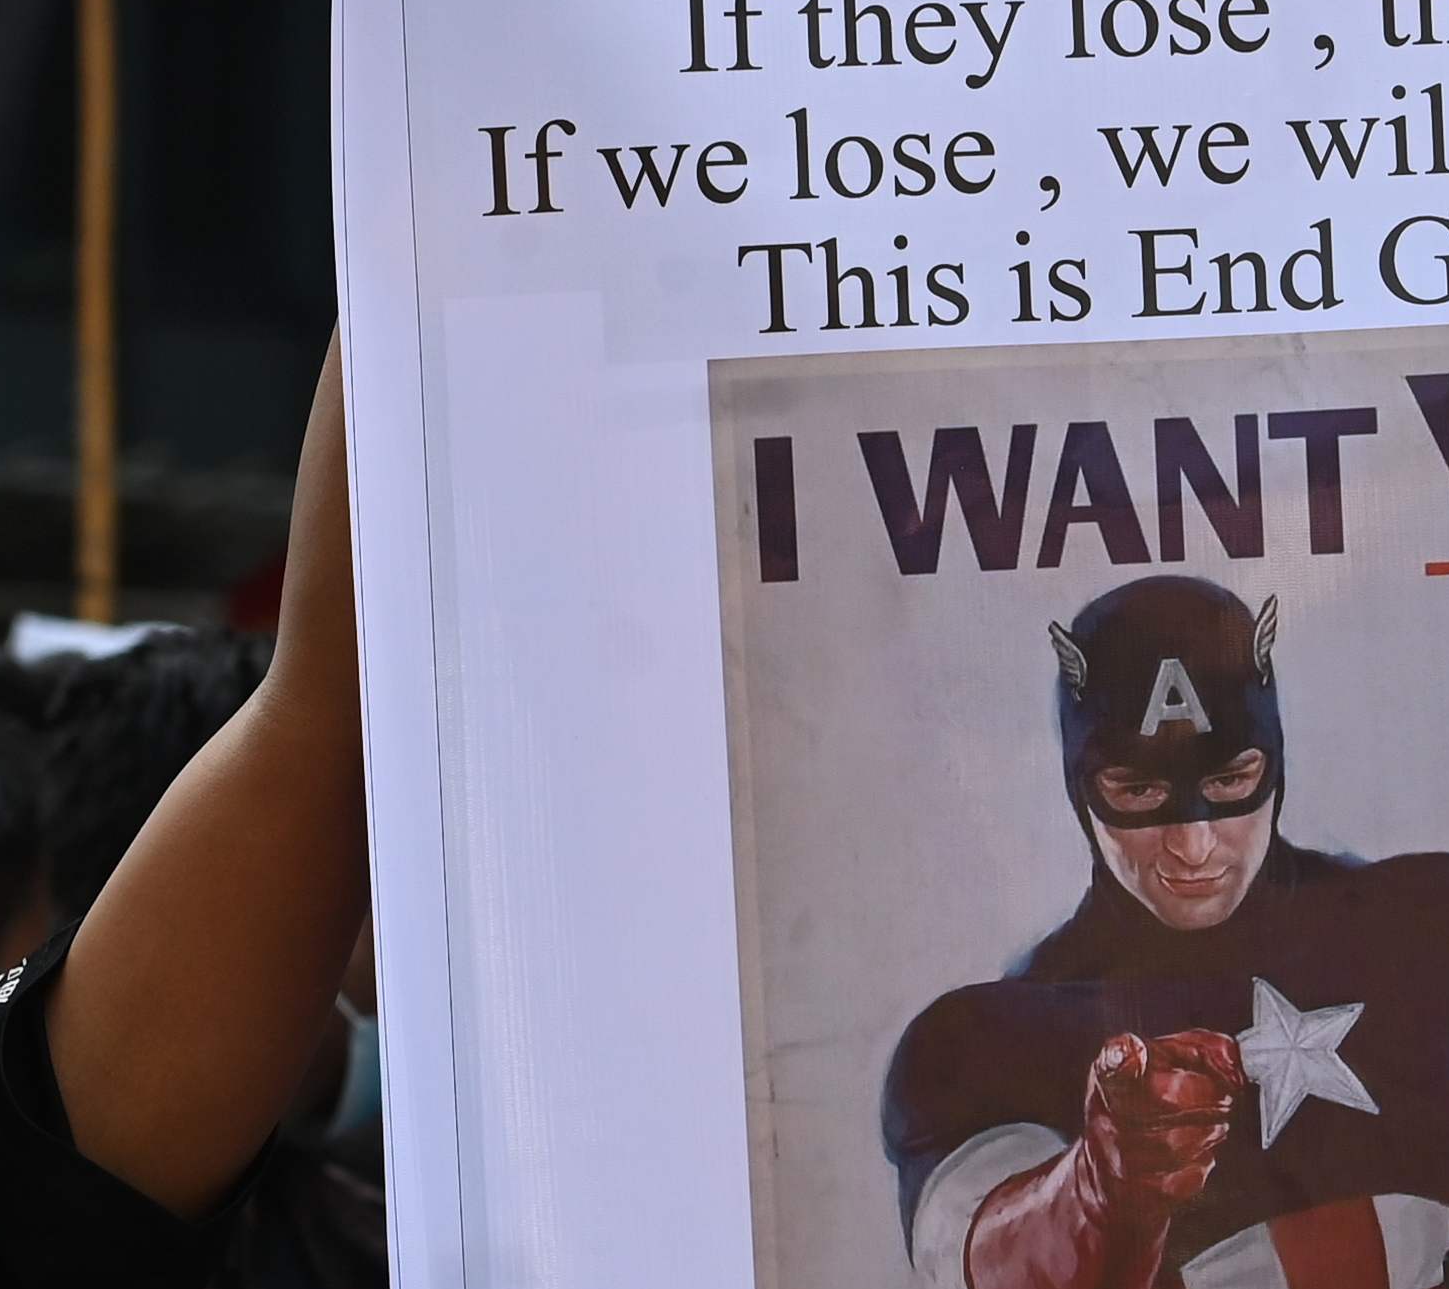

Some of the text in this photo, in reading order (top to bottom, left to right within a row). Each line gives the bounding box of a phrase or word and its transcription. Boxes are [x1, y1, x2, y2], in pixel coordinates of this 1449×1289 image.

[1314, 35, 1334, 70] ,
[478, 120, 576, 216] If
[597, 141, 748, 209] we
[786, 108, 995, 199] lose
[1040, 176, 1060, 211] ,
[1097, 123, 1249, 188] we
[738, 235, 969, 333] This
[1009, 231, 1091, 322] is
[1128, 218, 1343, 317] End
[754, 437, 799, 583] I
[857, 407, 1377, 576] WANT
